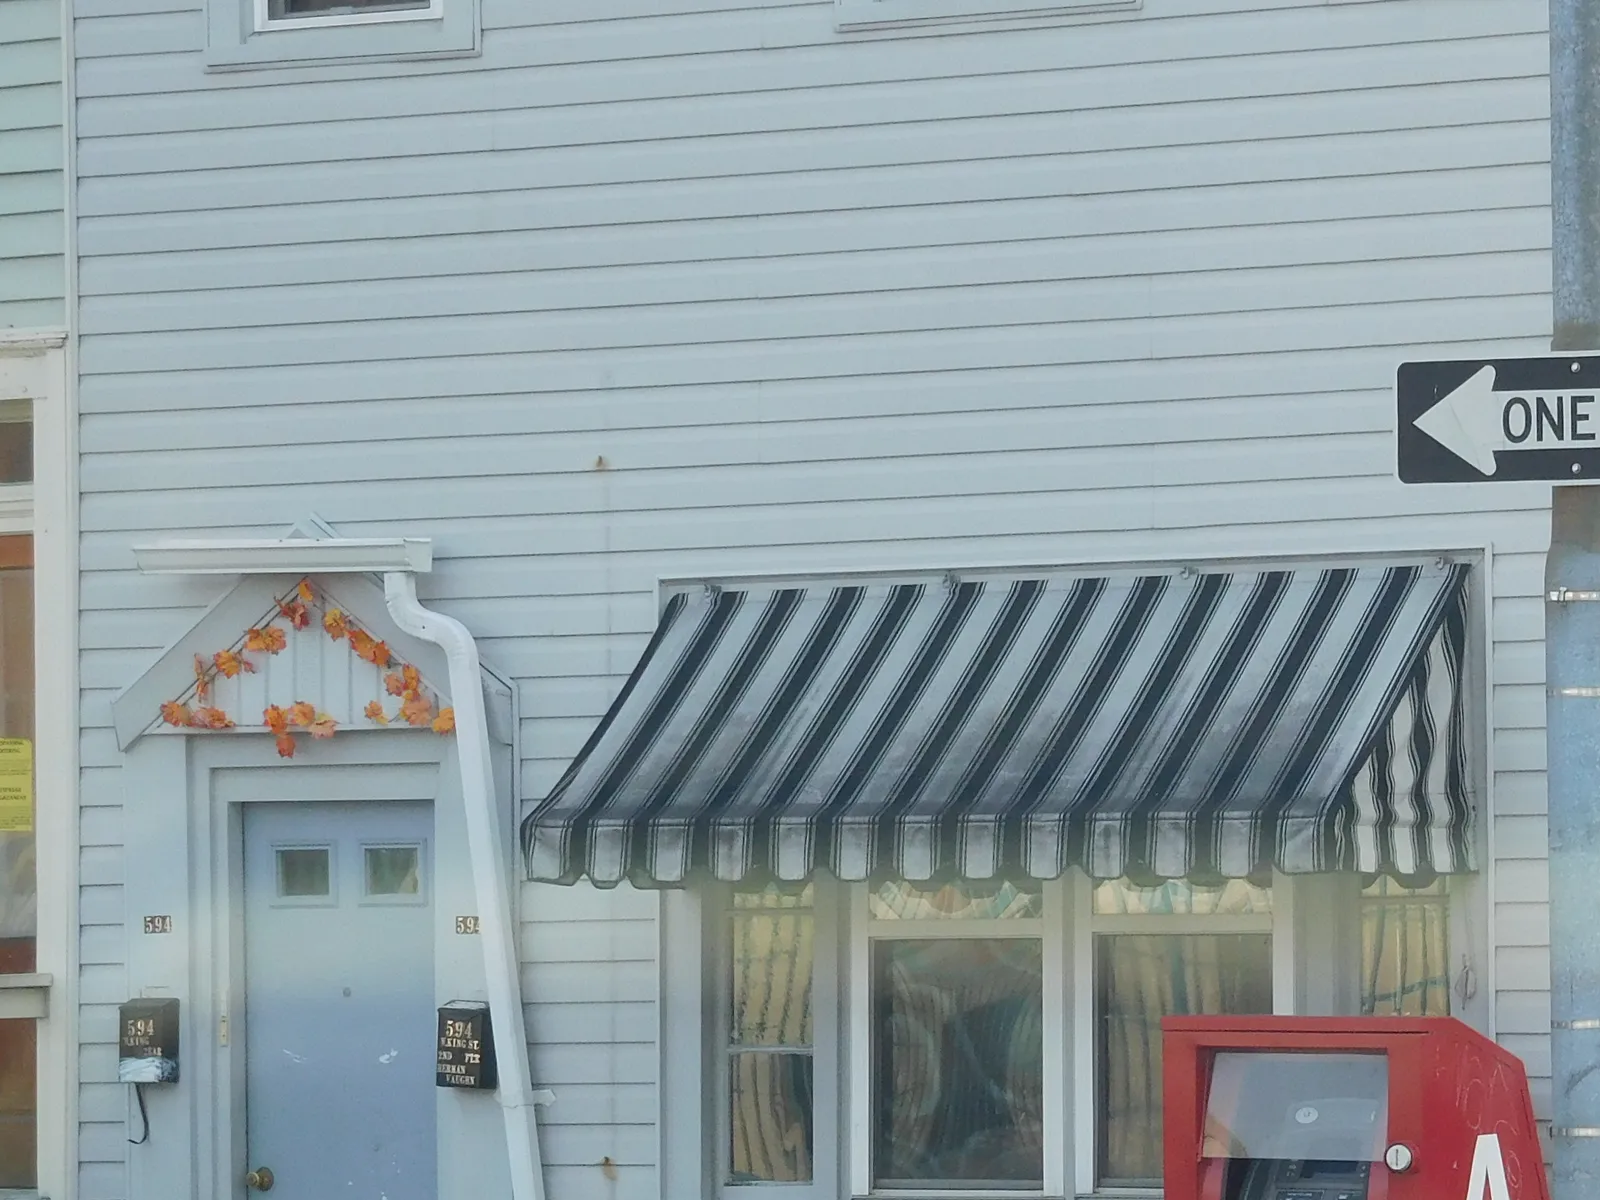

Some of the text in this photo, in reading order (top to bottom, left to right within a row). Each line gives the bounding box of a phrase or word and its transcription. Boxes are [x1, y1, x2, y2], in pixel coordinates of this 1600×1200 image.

[1502, 396, 1596, 443] ONE
[145, 916, 172, 933] 594
[127, 1020, 155, 1036] 594
[445, 1020, 473, 1039] 594
